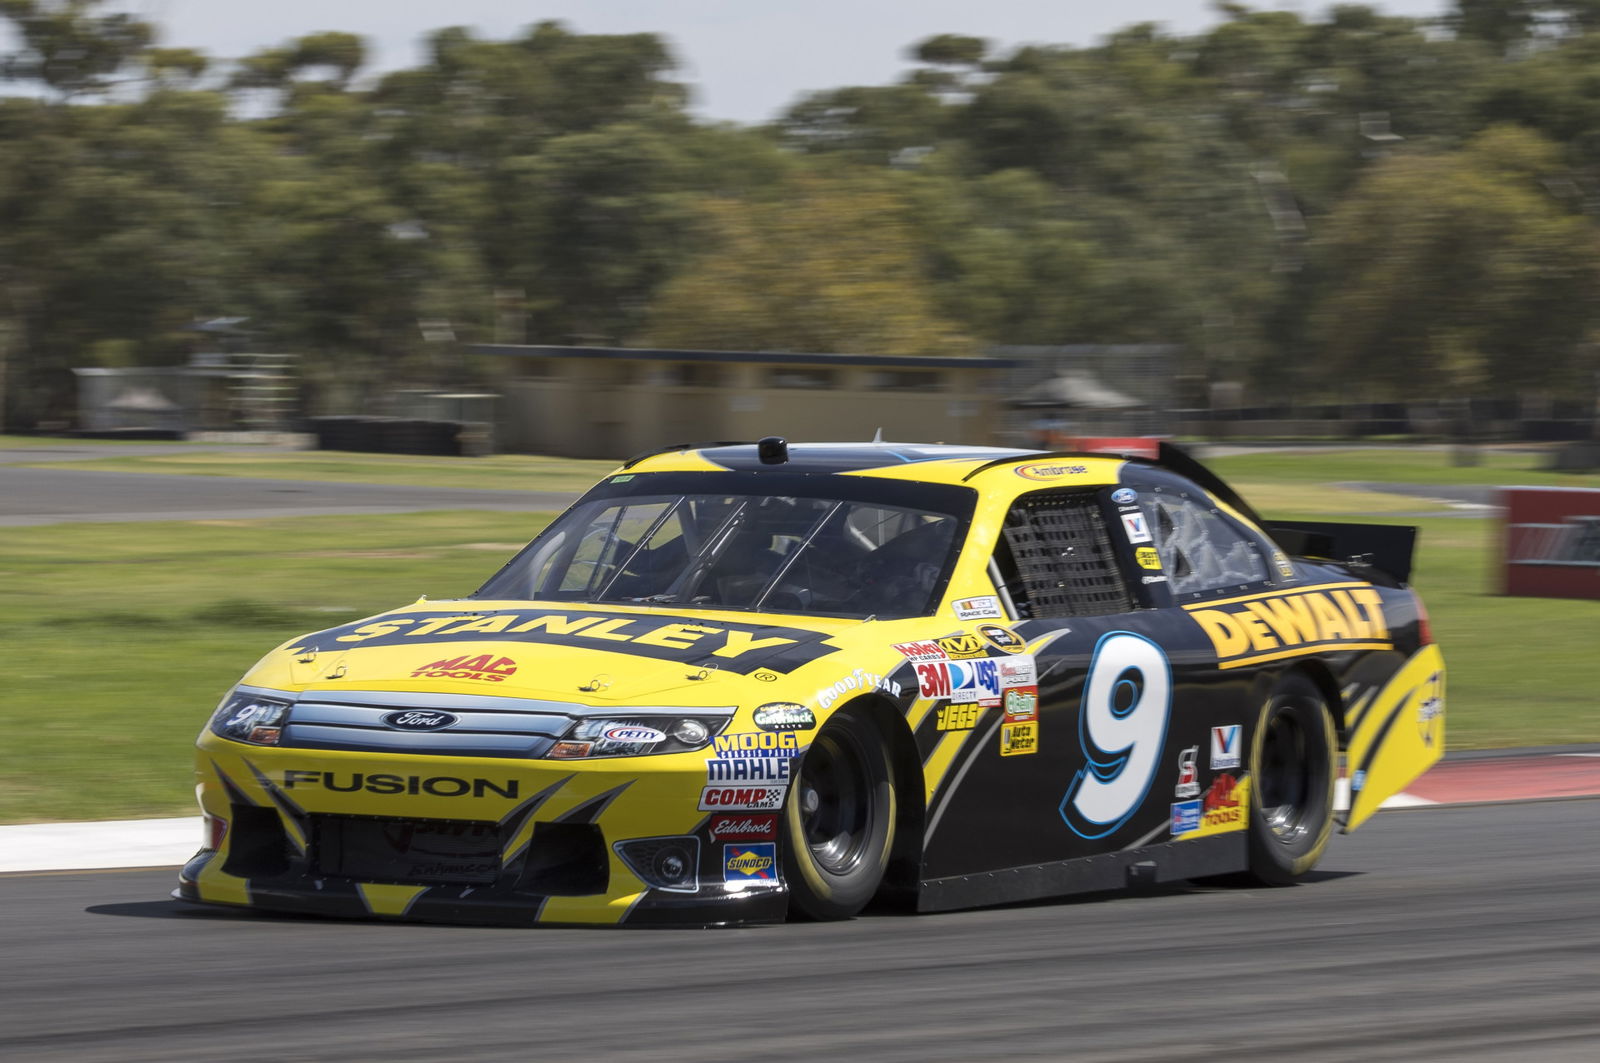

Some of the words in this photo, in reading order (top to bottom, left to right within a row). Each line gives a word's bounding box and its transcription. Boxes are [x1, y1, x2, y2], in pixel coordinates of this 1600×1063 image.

[1032, 465, 1088, 477] Ambrose
[335, 615, 799, 660] STANLEY
[894, 642, 947, 659] Holley
[416, 654, 517, 675] MAC
[409, 671, 508, 682] TOOLS
[918, 663, 951, 698] 3M
[975, 660, 999, 696] USG
[817, 667, 901, 709] GOODYEAR
[226, 704, 253, 726] 9
[396, 711, 441, 727] Ford
[937, 704, 978, 730] JEGS
[617, 728, 660, 741] PETTY
[714, 732, 797, 752] MOOG
[1060, 630, 1173, 839] 9
[720, 749, 762, 759] CHASSIS
[768, 748, 796, 758] PARTS
[708, 758, 788, 780] MAHLE
[283, 769, 519, 799] FUSION
[704, 789, 766, 806] COMP
[714, 819, 772, 834] Edelbrock
[728, 857, 771, 869] SUNOCO
